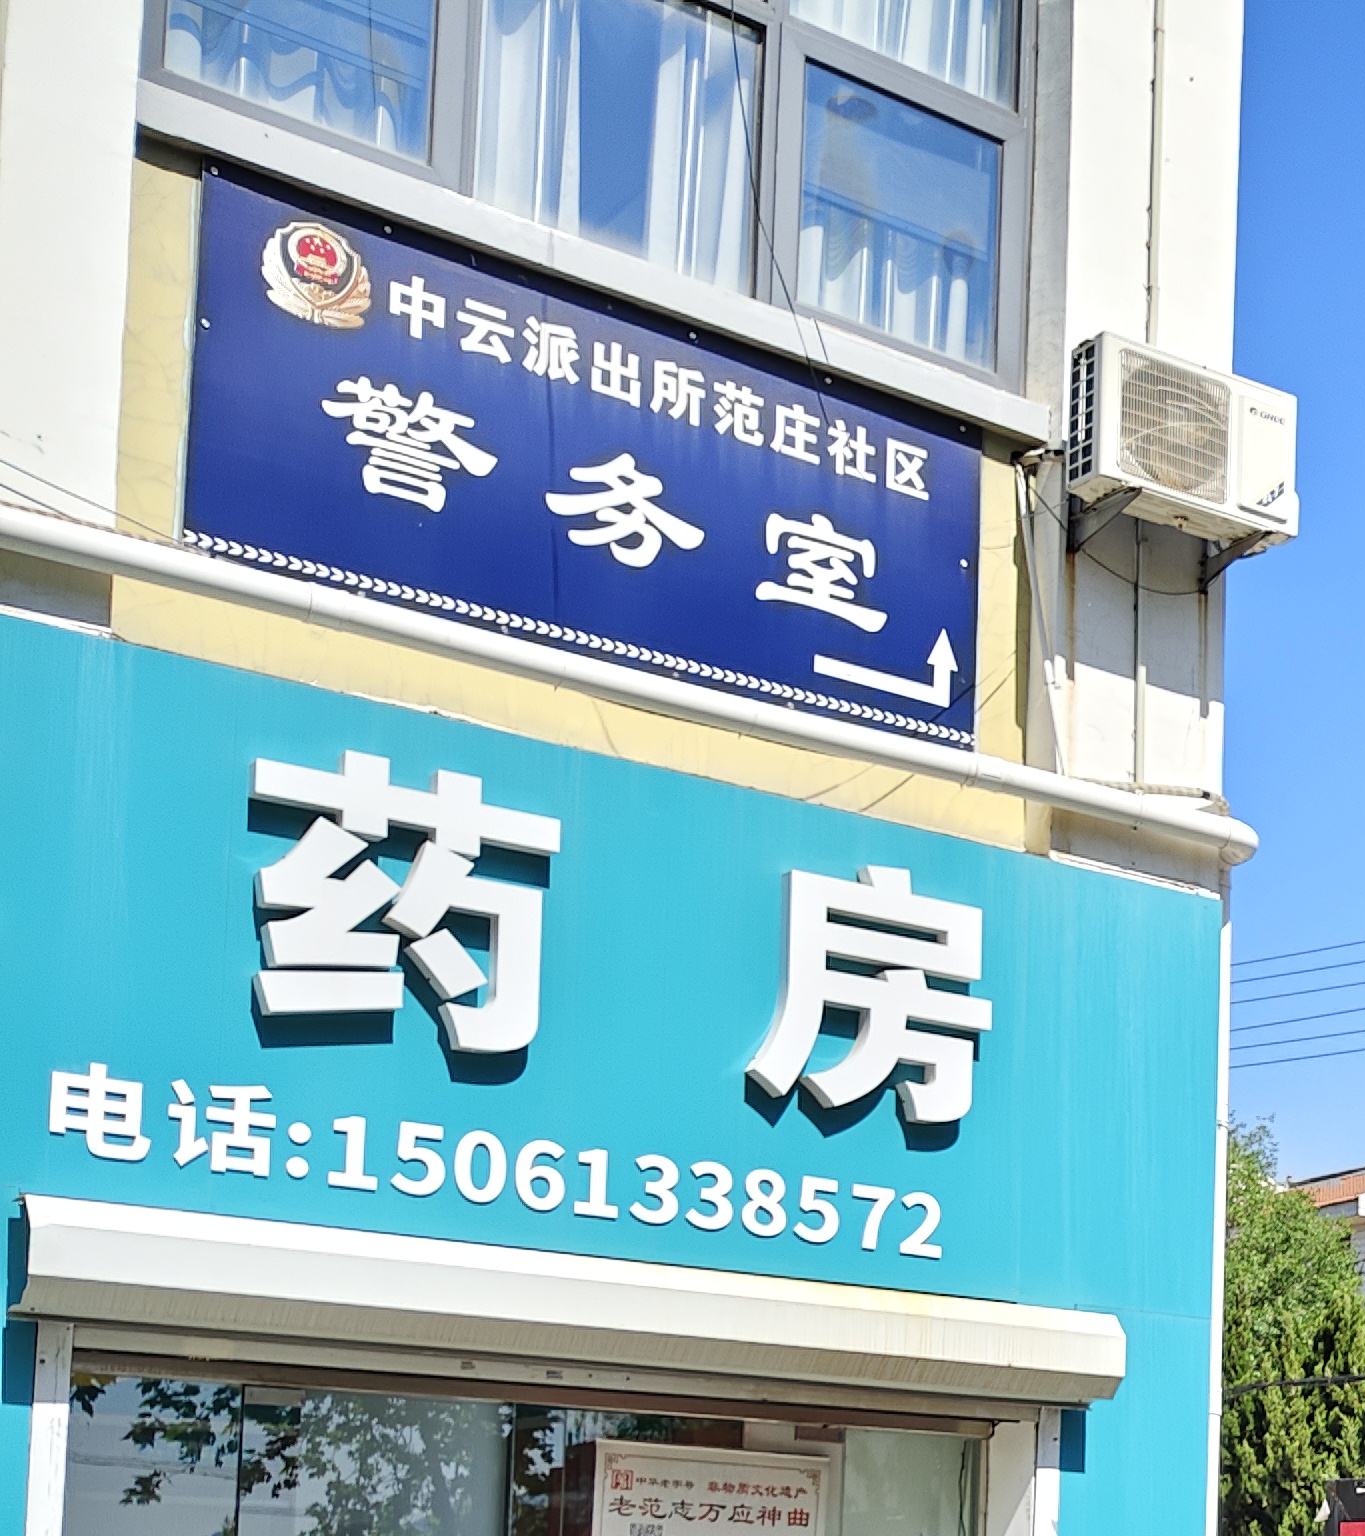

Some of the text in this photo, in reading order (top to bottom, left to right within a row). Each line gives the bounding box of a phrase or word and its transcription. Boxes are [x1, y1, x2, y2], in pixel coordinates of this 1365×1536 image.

[389, 274, 931, 502] 中云派出所范庄社区
[48, 1062, 944, 1261] 电话:15061338572
[608, 1494, 810, 1527] 老范志万应神曲
